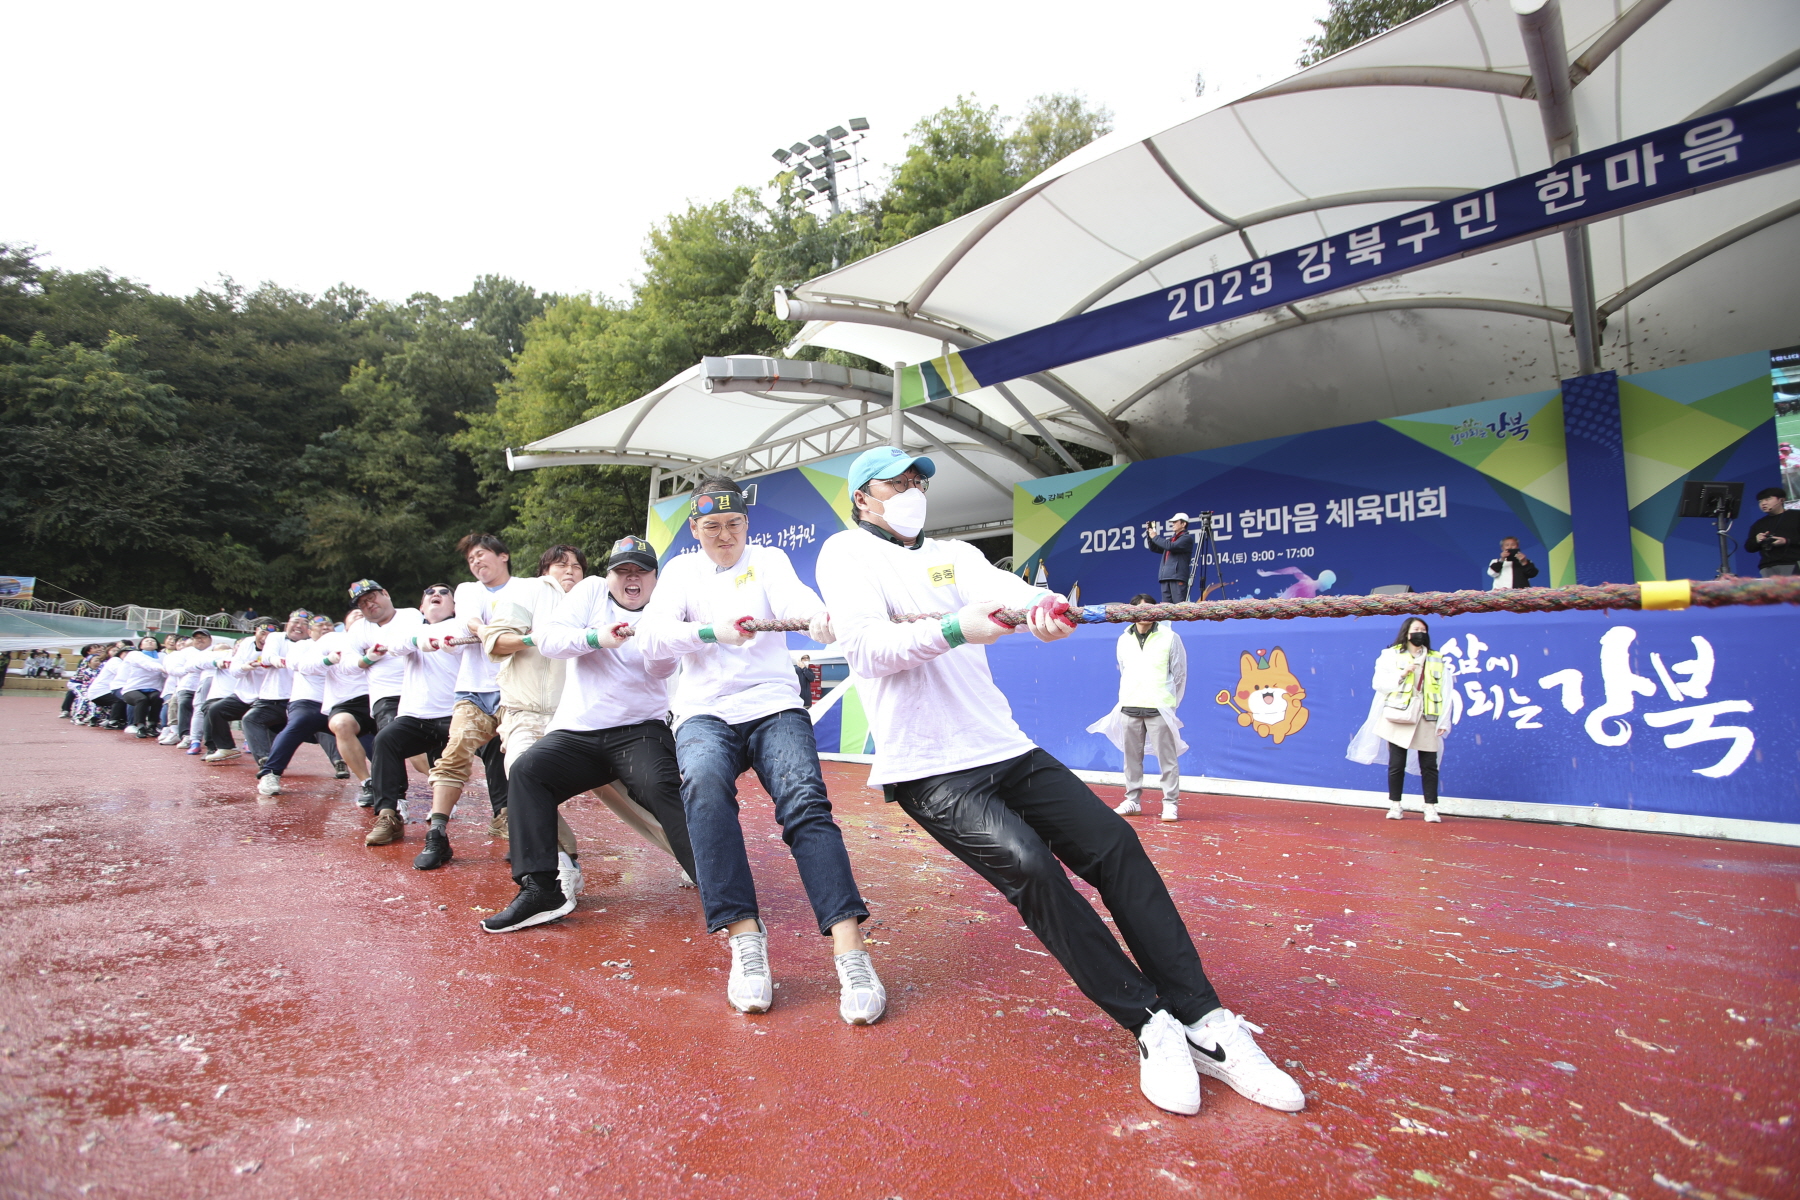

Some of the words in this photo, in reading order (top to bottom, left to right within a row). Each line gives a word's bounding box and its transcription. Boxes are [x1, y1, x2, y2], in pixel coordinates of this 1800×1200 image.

[1167, 261, 1272, 322] 2023
[1297, 191, 1498, 285] 강북구민
[1535, 118, 1743, 216] 한마음
[1485, 411, 1529, 441] 강북
[1048, 491, 1073, 502] 강북구
[1080, 526, 1135, 554] 2023
[1239, 502, 1319, 538] 한마음
[1325, 486, 1447, 528] 체육대회
[778, 524, 815, 551] 강북구민
[1251, 550, 1275, 562] 9:00
[1285, 547, 1315, 559] 17:00
[1538, 625, 1756, 778] 강북
